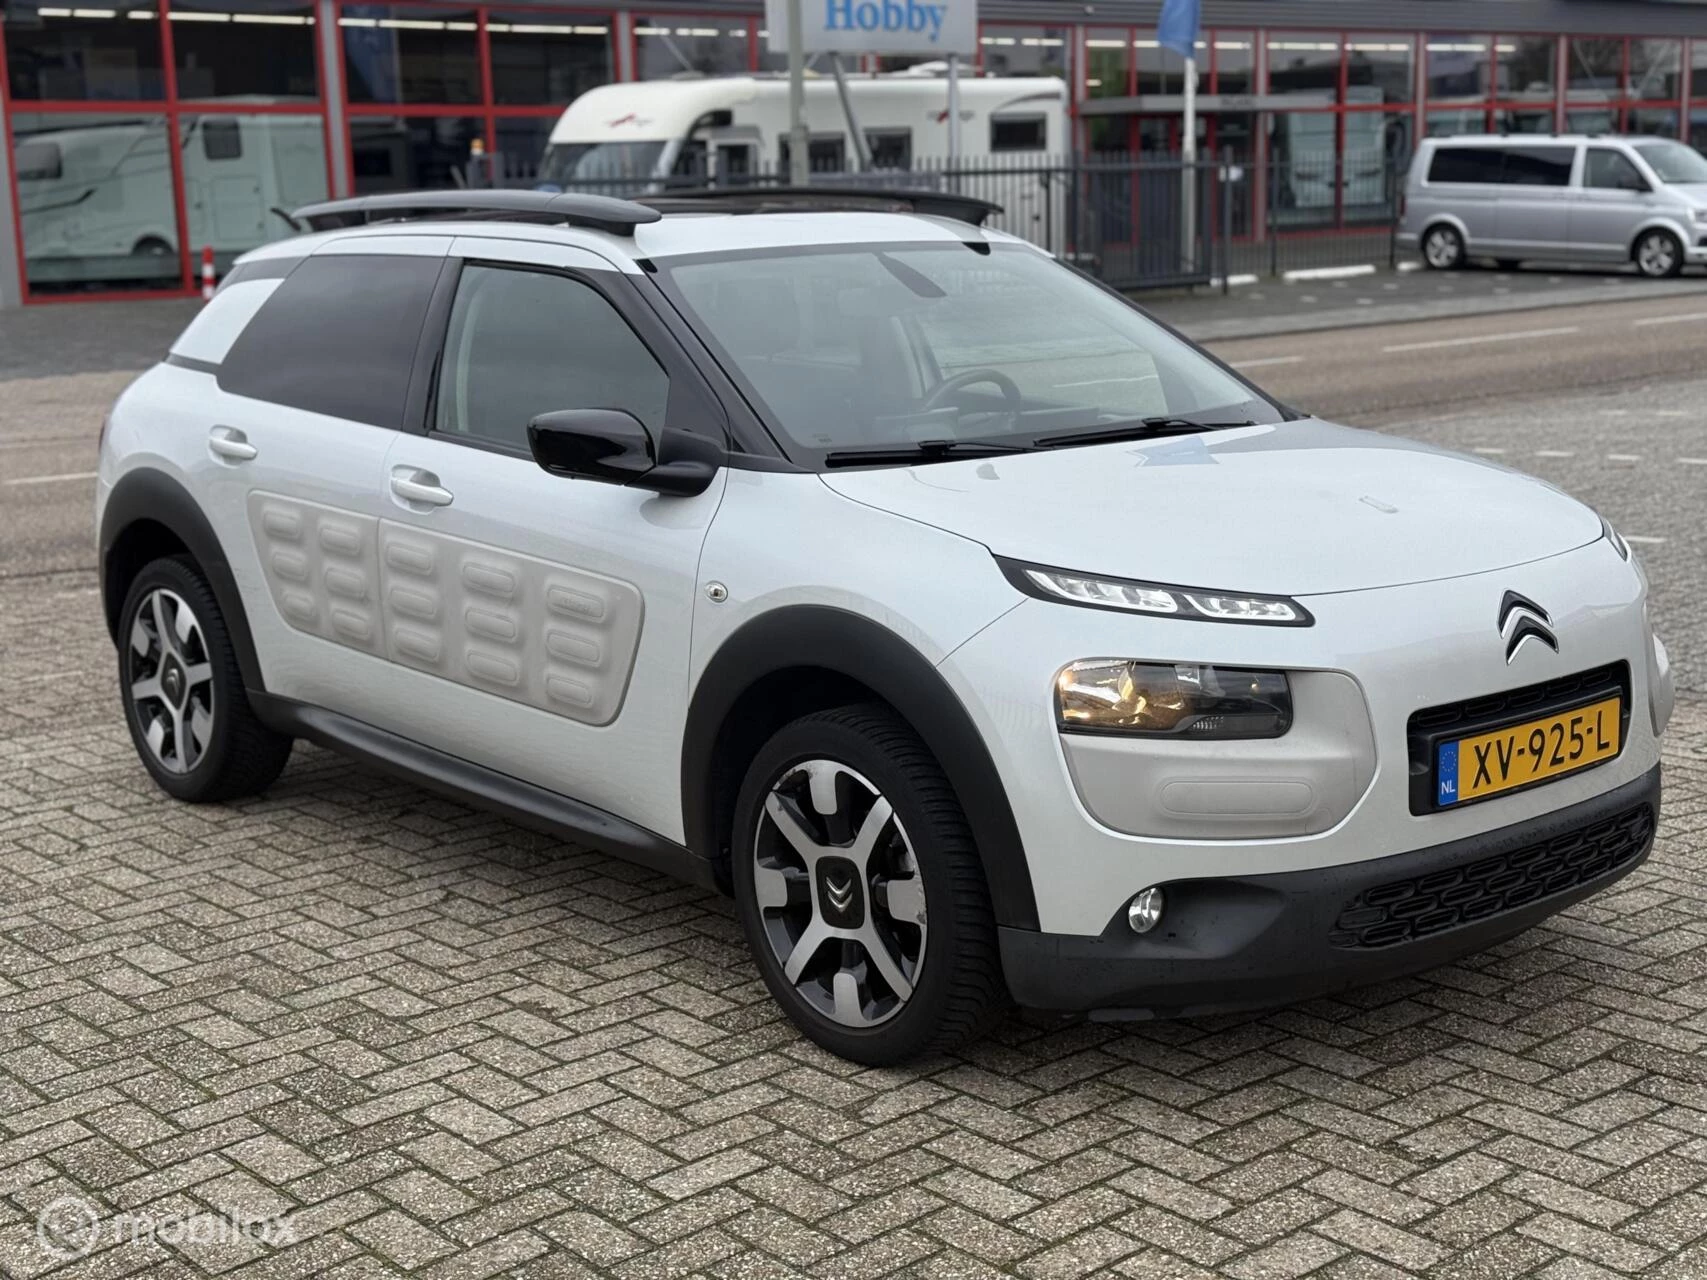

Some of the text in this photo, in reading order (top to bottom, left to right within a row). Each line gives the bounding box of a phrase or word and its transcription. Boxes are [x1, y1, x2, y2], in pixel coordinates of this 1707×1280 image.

[824, 0, 946, 42] Hobby
[1472, 710, 1610, 789] XV-925-L
[1441, 780, 1456, 794] NL
